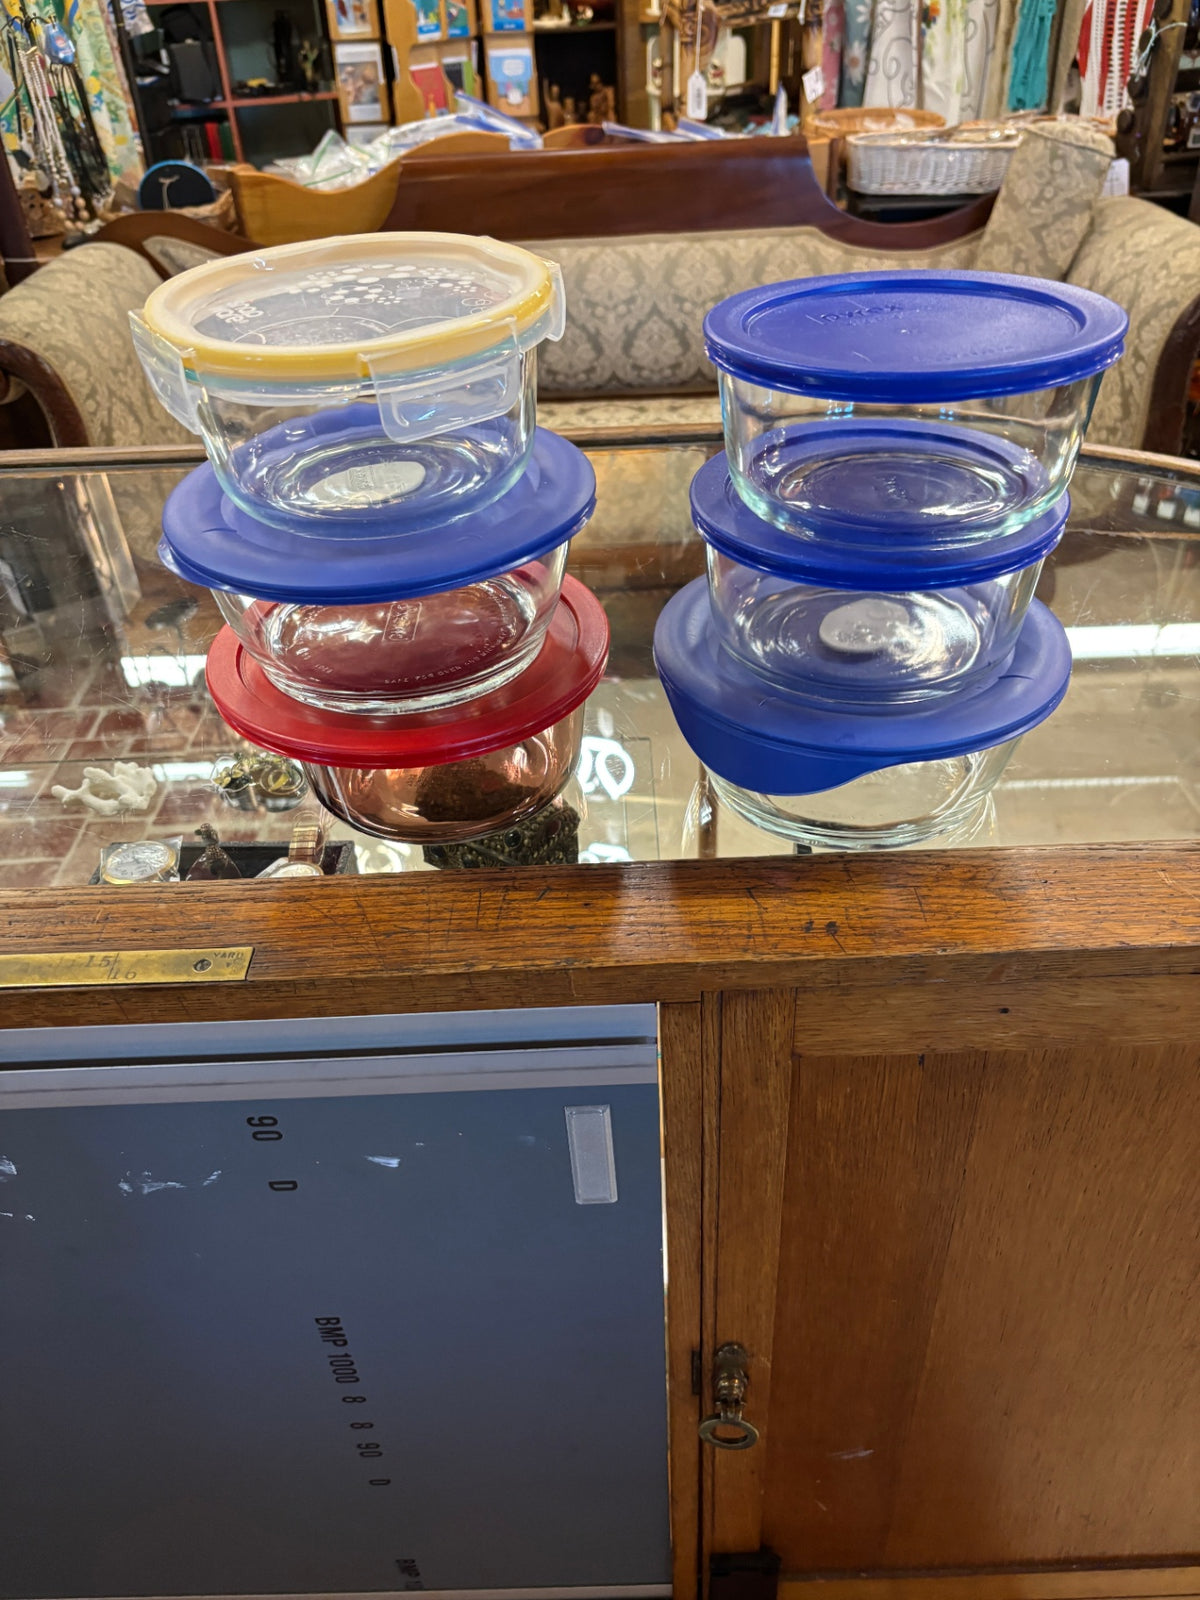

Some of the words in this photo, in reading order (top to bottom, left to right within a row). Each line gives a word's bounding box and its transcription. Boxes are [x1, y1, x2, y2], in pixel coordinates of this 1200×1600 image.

[246, 1115, 283, 1141] 90
[314, 1317, 348, 1347] BMP
[327, 1352, 360, 1383] 1000
[356, 1443, 382, 1457] 90
